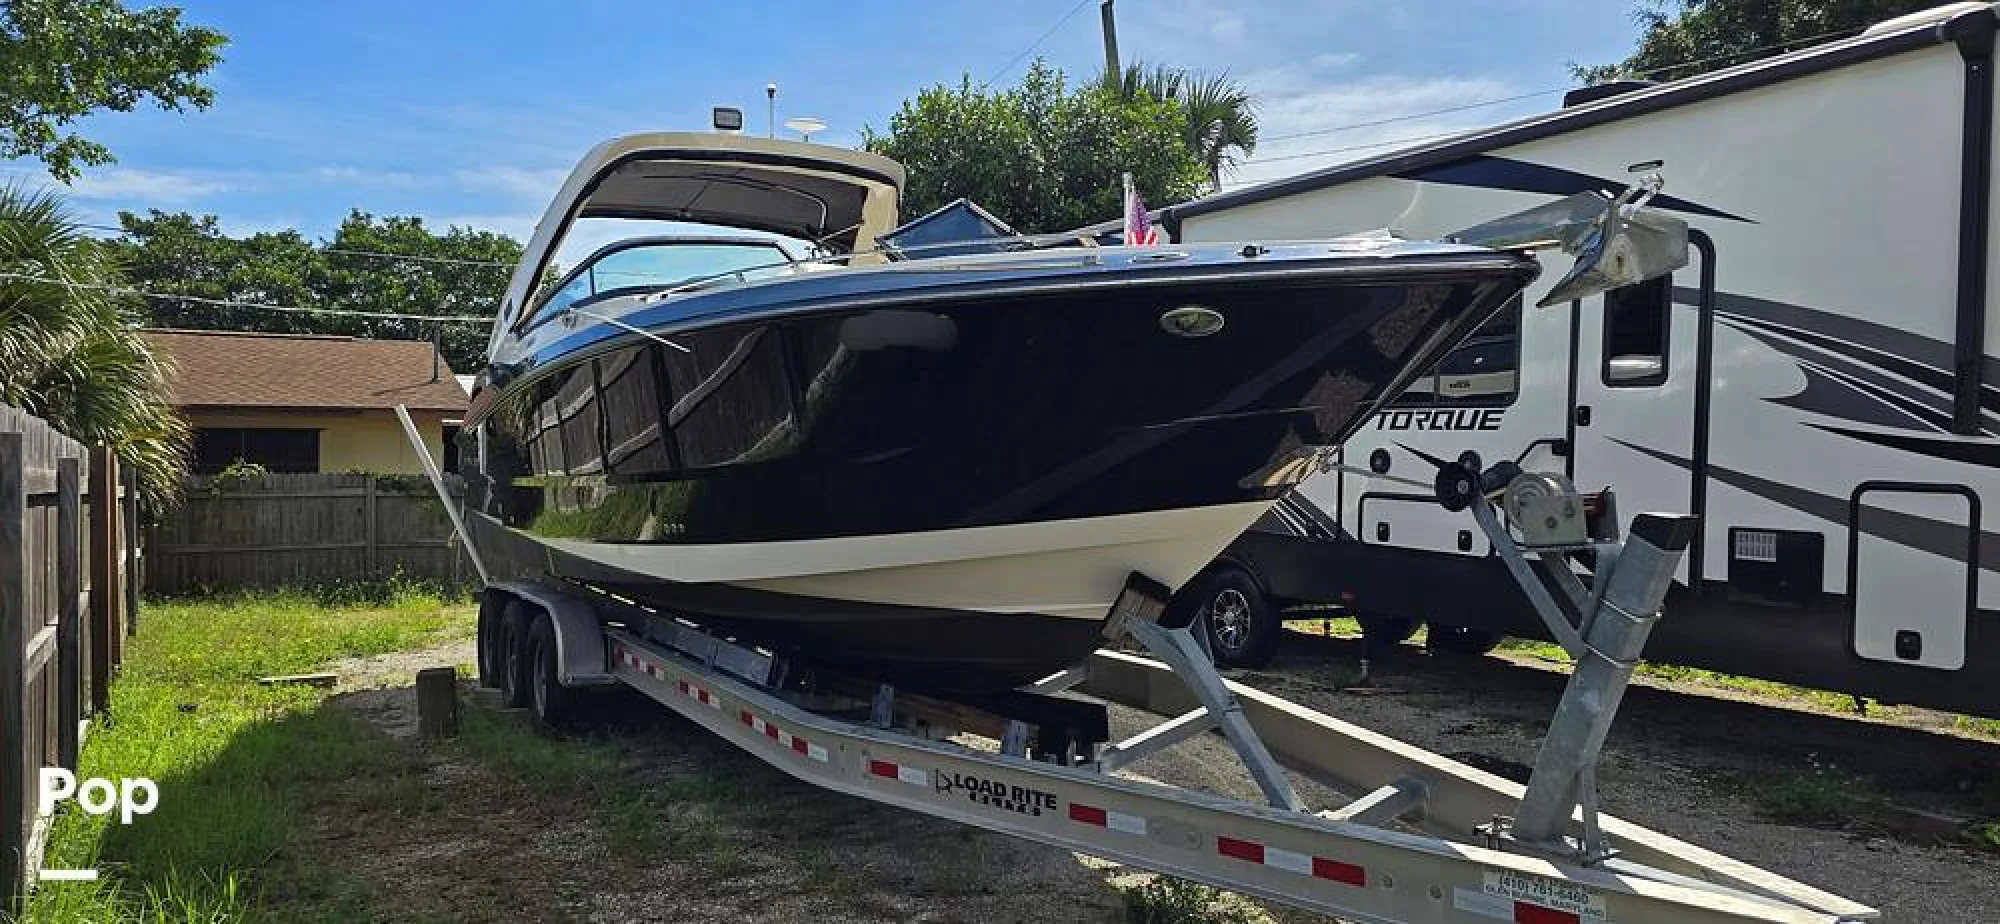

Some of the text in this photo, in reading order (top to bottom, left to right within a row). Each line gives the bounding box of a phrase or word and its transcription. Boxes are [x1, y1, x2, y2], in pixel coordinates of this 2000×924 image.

[1376, 409, 1506, 431] TORQUE
[954, 773, 1007, 797] LOAD
[1011, 785, 1057, 811] RITE
